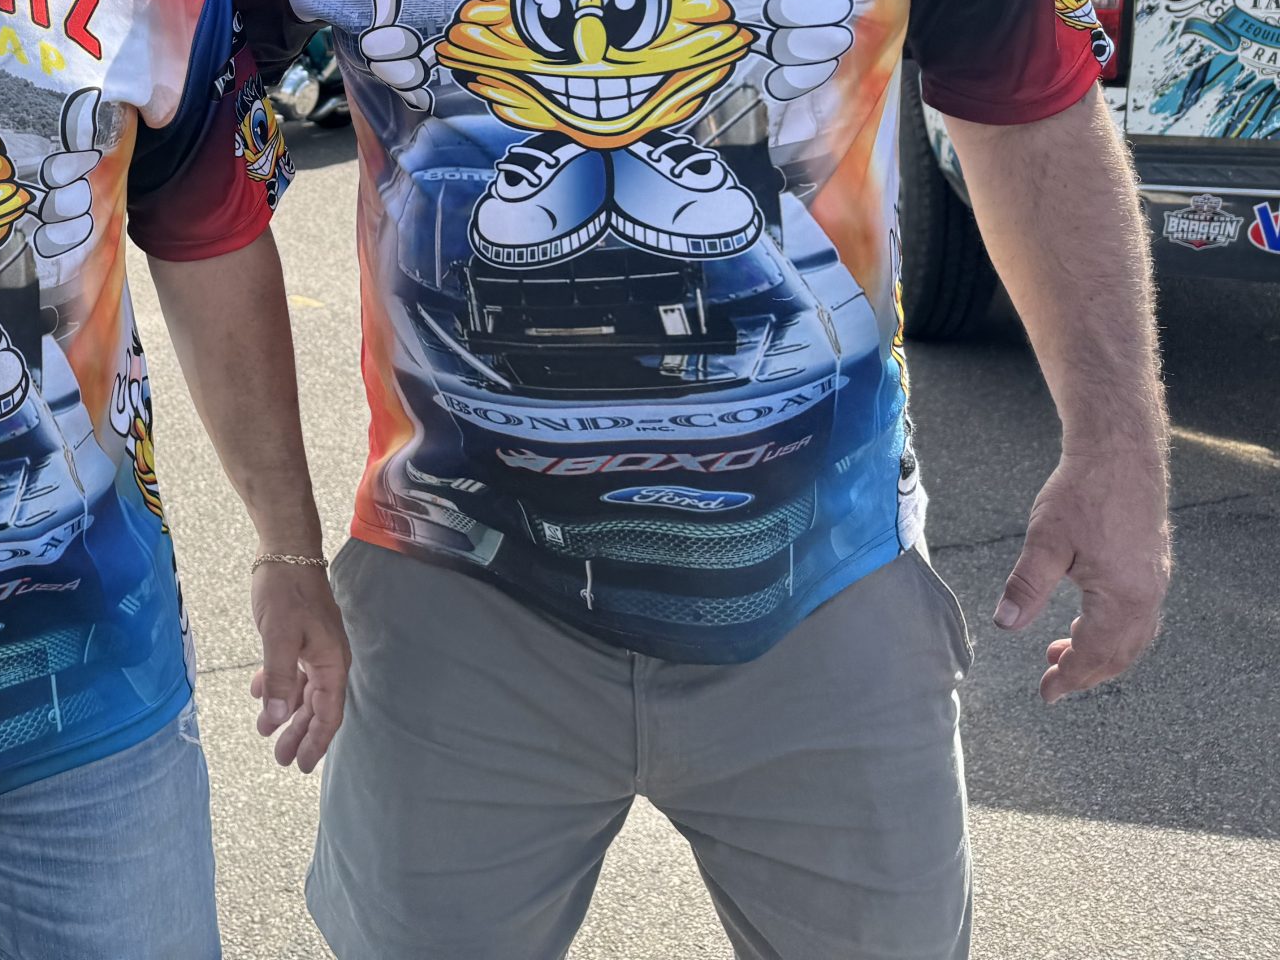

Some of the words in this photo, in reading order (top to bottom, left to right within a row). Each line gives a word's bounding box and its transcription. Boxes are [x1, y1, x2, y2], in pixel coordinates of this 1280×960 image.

[1167, 216, 1237, 237] BRAGGIN
[1173, 231, 1226, 241] RIGHTS
[764, 434, 813, 461] USA
[632, 486, 725, 510] Ford
[15, 577, 81, 595] USA
